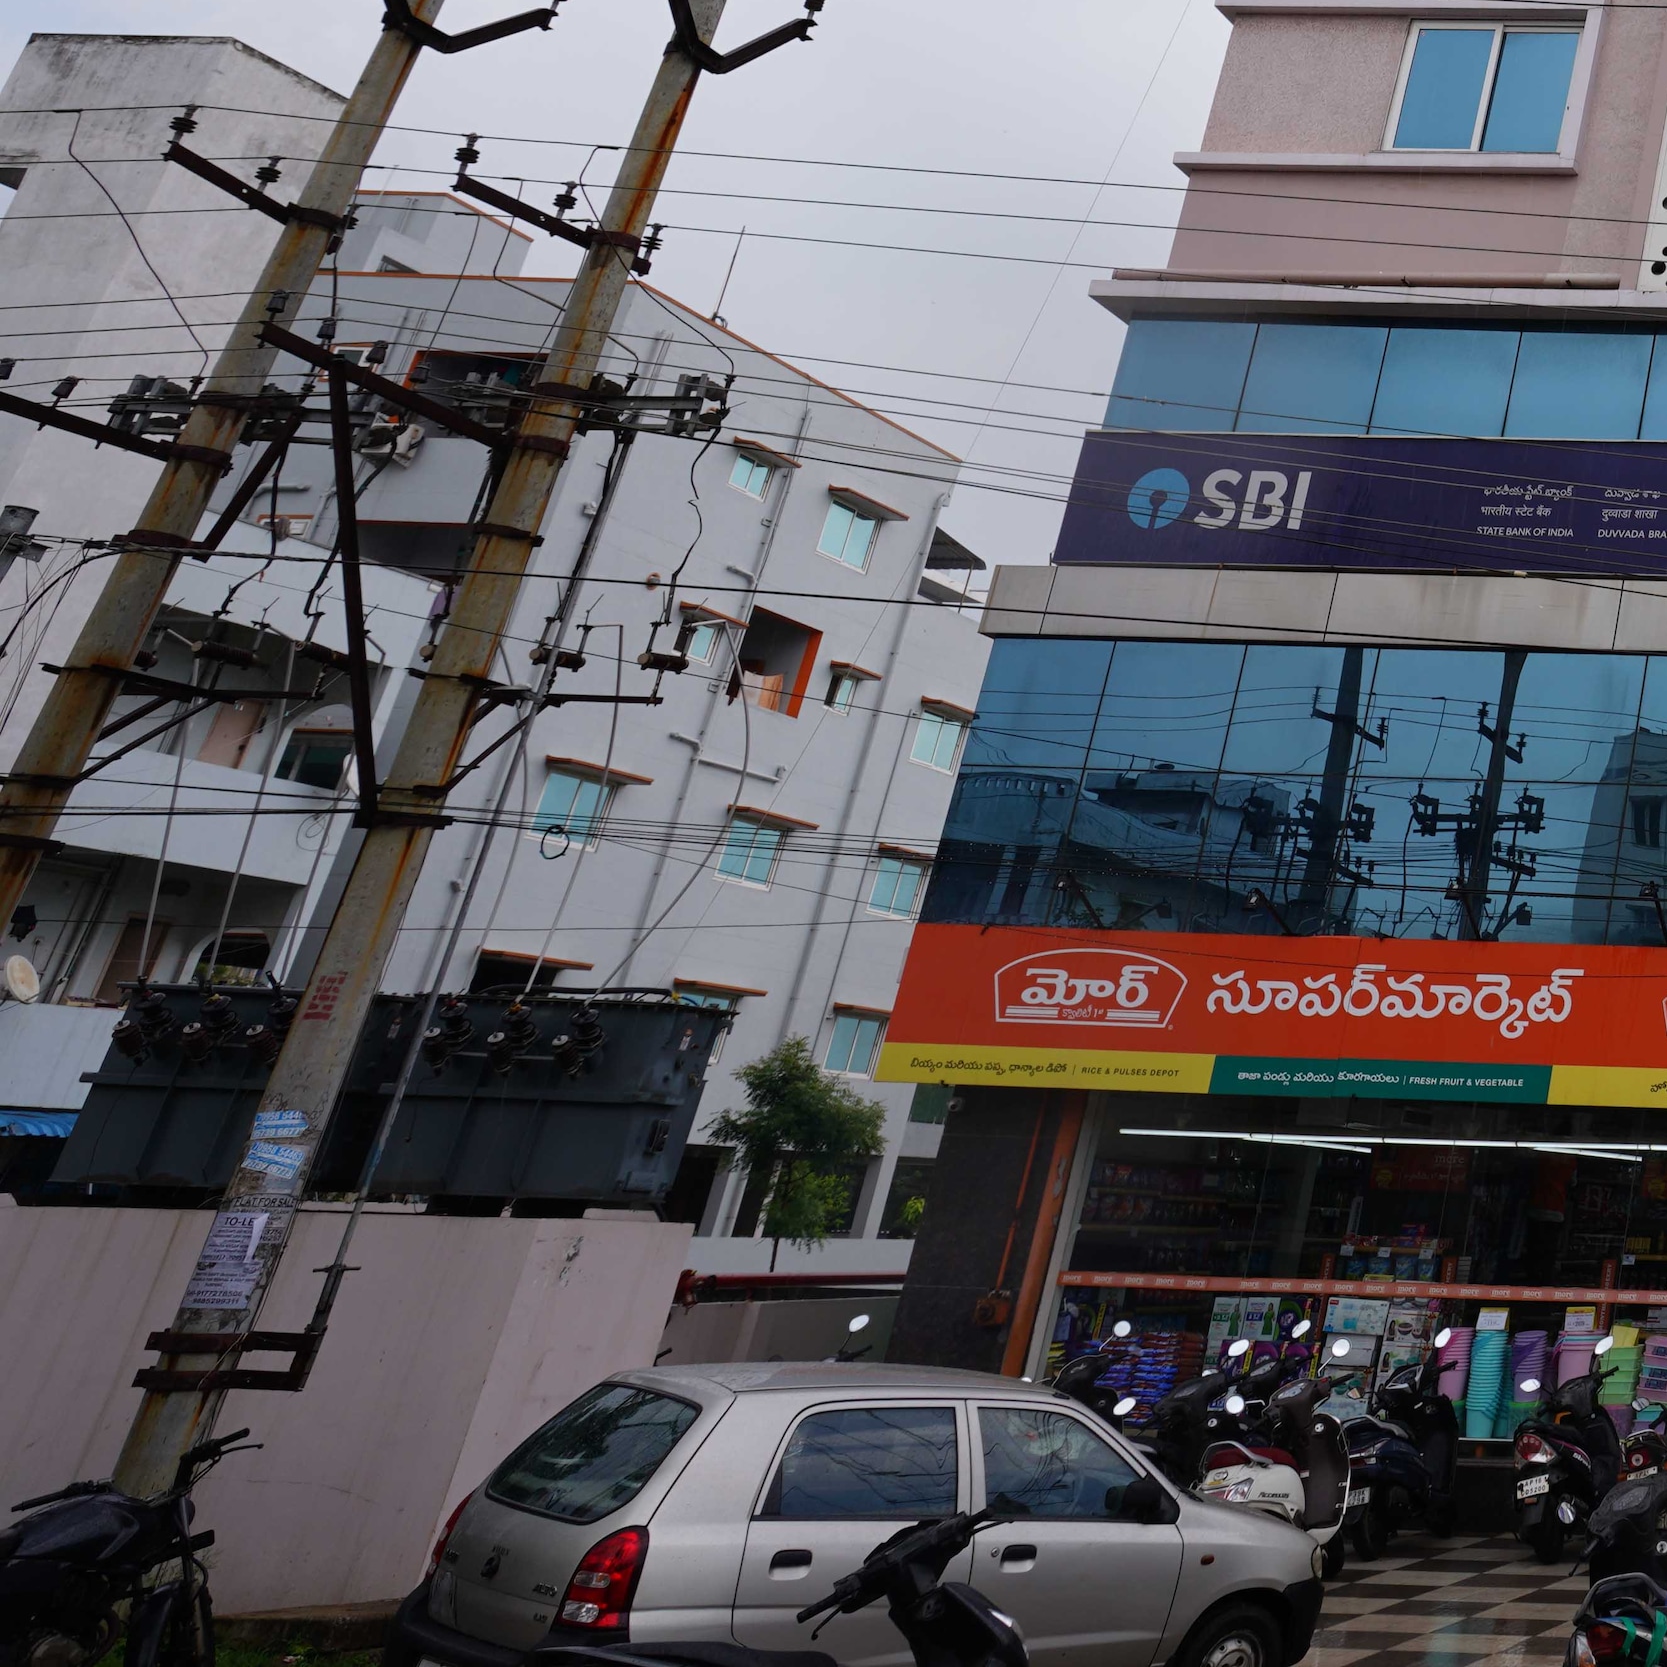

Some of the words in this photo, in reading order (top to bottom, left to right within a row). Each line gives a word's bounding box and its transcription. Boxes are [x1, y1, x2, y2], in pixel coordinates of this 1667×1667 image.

[1193, 468, 1312, 531] SBI
[1480, 504, 1512, 517] भारतीय
[1515, 505, 1533, 517] स्टेट
[1634, 509, 1658, 520] शाखा
[1476, 526, 1504, 536] STATE
[1506, 527, 1531, 536] BANK
[1533, 527, 1546, 537] OF
[1547, 527, 1574, 537] INDIA
[1597, 529, 1644, 539] DUVVADA
[1021, 965, 1159, 1008] మోర్
[1081, 1066, 1102, 1075] RICE
[1113, 1067, 1148, 1077] PULSES
[1150, 1069, 1180, 1078] DEPOT
[1409, 1077, 1437, 1086] FRESH
[1439, 1077, 1465, 1086] FRUIT
[1474, 1078, 1524, 1087] VEGETABLE
